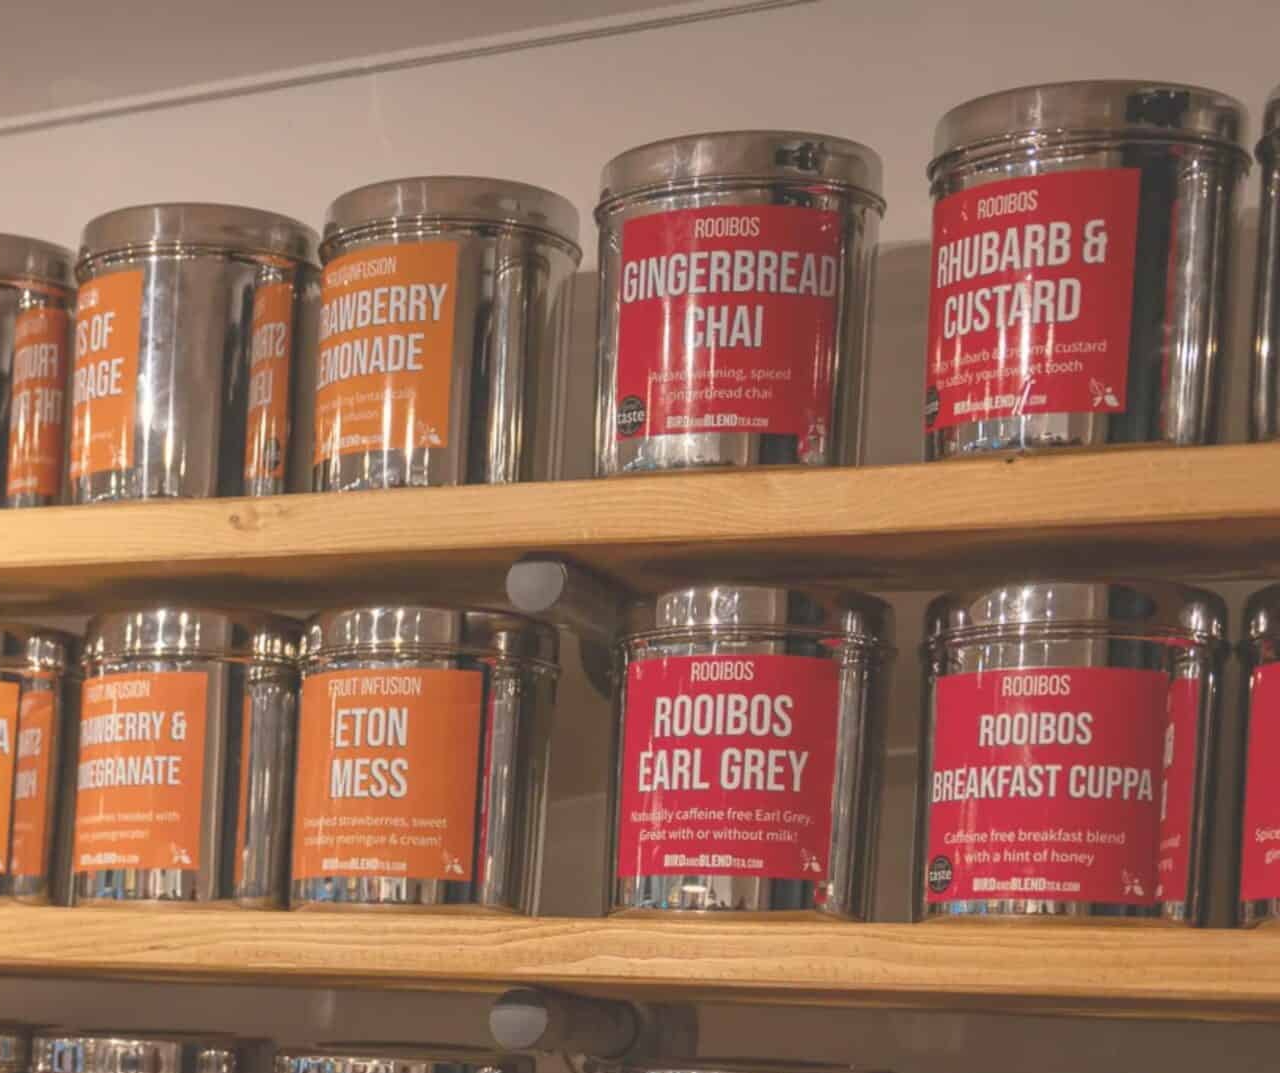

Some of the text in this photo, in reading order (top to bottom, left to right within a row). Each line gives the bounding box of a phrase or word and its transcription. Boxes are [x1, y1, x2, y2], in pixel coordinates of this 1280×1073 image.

[977, 190, 1039, 220] ROOIBOS
[694, 216, 760, 239] ROOIBOS
[937, 219, 1108, 288] RHUBARB &
[623, 249, 836, 302] GINGERBREAD
[321, 283, 448, 341] RAWBERRY
[944, 277, 1081, 339] CUSTARD
[91, 312, 115, 351] OF
[685, 304, 764, 348] CHAI
[751, 368, 792, 380] spiced
[360, 676, 421, 696] INFUSION
[691, 661, 754, 682] ROOIBOS
[1002, 674, 1071, 697] ROOIBOS
[171, 711, 187, 741] &
[335, 707, 408, 748] ETON
[654, 694, 794, 737] ROOIBOS
[978, 712, 1094, 747] ROOIBOS
[330, 757, 408, 799] MESS
[638, 748, 809, 793] EARL GREY
[932, 765, 1153, 803] BREAKFAST CUPPA
[675, 807, 724, 822] caffeine
[727, 807, 753, 821] free
[755, 809, 780, 822] Earl
[668, 828, 693, 841] with
[696, 830, 709, 841] or
[713, 828, 764, 841] without
[990, 829, 1016, 843] free
[1018, 828, 1082, 844] breakfast
[1086, 831, 1126, 846] blend
[964, 850, 1095, 865] with a hint of honey
